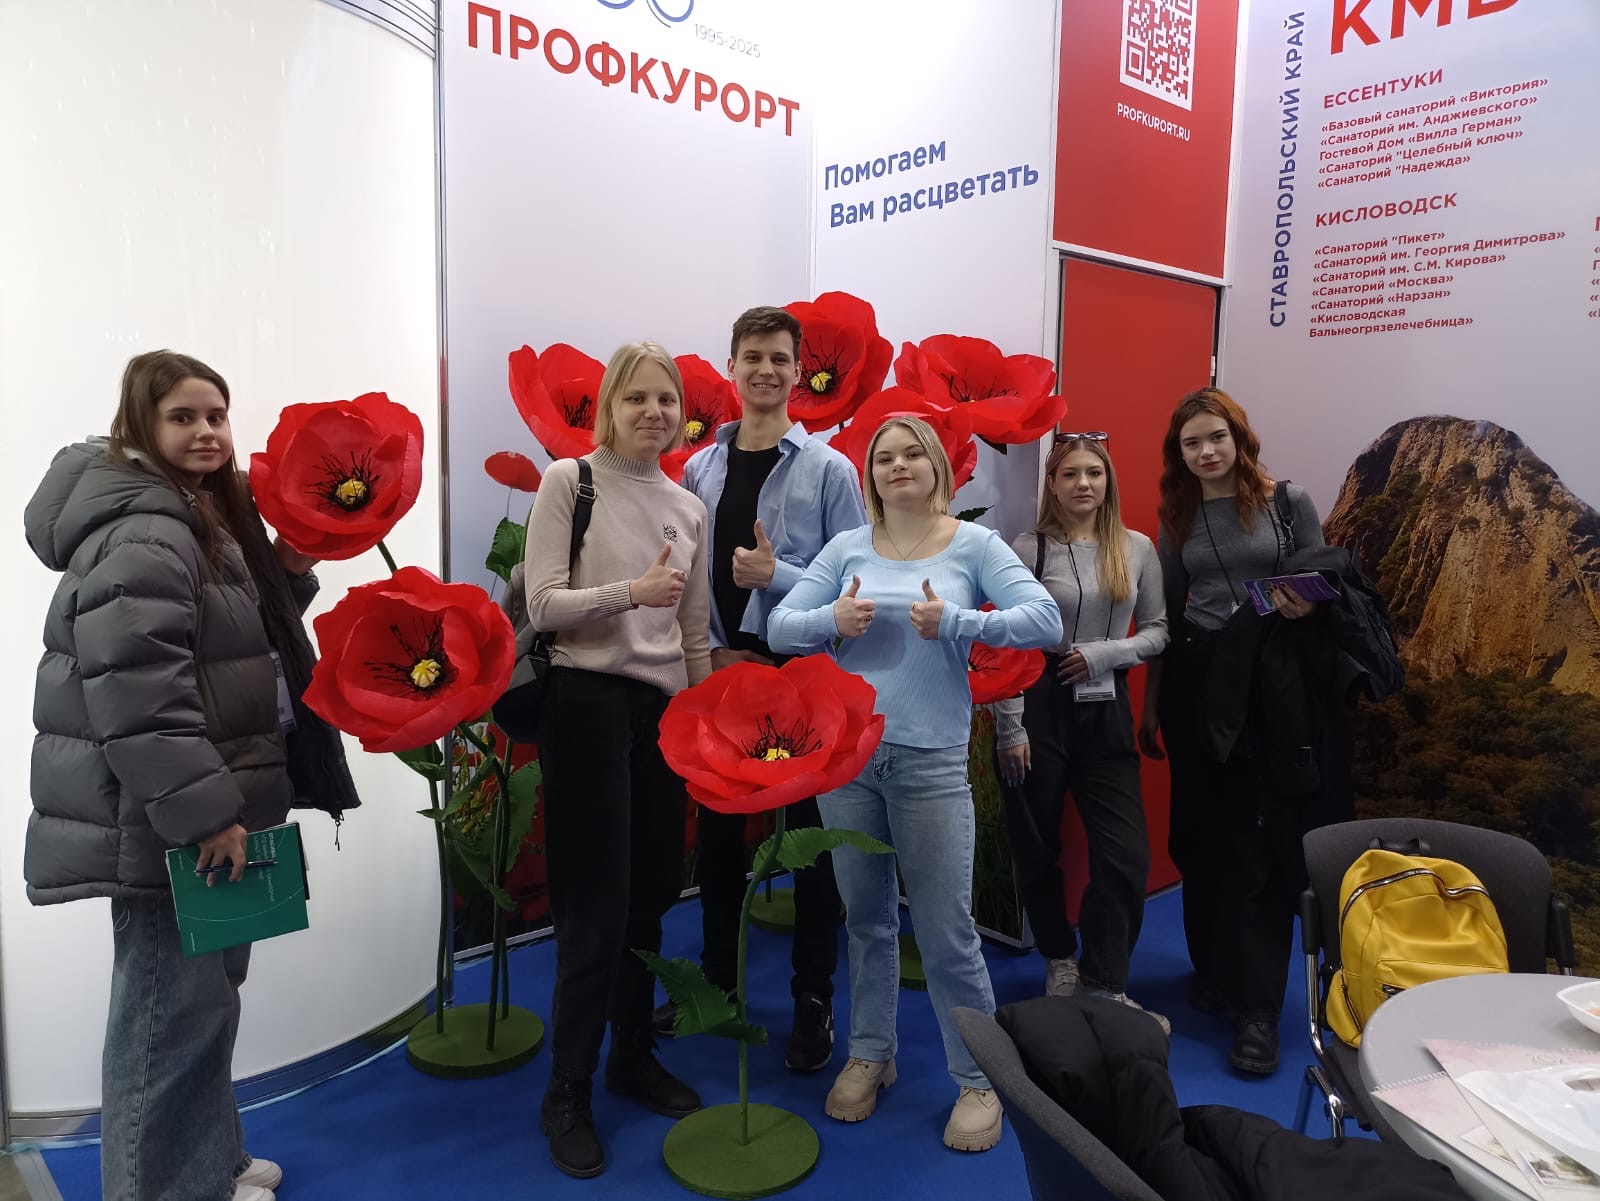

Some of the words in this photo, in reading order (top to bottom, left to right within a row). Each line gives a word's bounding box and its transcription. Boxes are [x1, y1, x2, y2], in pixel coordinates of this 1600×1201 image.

[694, 23, 761, 58] 1995-2025
[1283, 11, 1305, 81] КРАЙ
[468, 1, 800, 137] ПРОФКУРОРТ
[1323, 69, 1444, 109] ЕССЕНТУКИ
[1117, 102, 1191, 141] PROFKURORT.RU
[1320, 124, 1395, 147] «Санаторий
[1398, 121, 1418, 133] им.
[1423, 96, 1538, 128] Анджиевского»
[1321, 112, 1382, 133] «Базовый
[1385, 96, 1456, 120] санаторий
[1460, 77, 1548, 104] «Виктория»
[1318, 153, 1392, 175] «Санаторий
[1396, 137, 1472, 161] "Целебный
[1477, 129, 1523, 147] ключ»
[1320, 143, 1374, 161] Гостевой
[1377, 137, 1404, 153] Дом
[1408, 127, 1458, 144] «Вилла
[1461, 114, 1522, 135] Герман»
[824, 140, 946, 190] Помогаем
[1318, 167, 1391, 189] «Санаторий
[1395, 155, 1471, 177] "Надежда»
[830, 200, 874, 228] Вам
[883, 164, 1039, 222] расцветать
[1269, 87, 1301, 328] СТАВРОПОЛЬСКИЙ
[1315, 192, 1458, 228] КИСЛОВОДСК
[1314, 237, 1388, 257] «Санаторий
[1392, 230, 1445, 246] "Пикет»
[1314, 251, 1387, 270] «Санаторий
[1391, 249, 1411, 261] им.
[1415, 241, 1469, 262] Георгия
[1473, 230, 1565, 253] Димитрова»
[1312, 279, 1385, 298] «Санаторий
[1388, 273, 1454, 289] «Москва»
[1313, 265, 1386, 284] «Санаторий
[1389, 263, 1410, 275] им.
[1414, 259, 1441, 273] С.М.
[1445, 253, 1506, 271] Кирова»
[1310, 306, 1405, 325] «Кисловодская
[1311, 294, 1384, 312] «Санаторий
[1387, 288, 1451, 305] «Нарзан»
[1309, 315, 1474, 338] Бальнеогрязелечебница»
